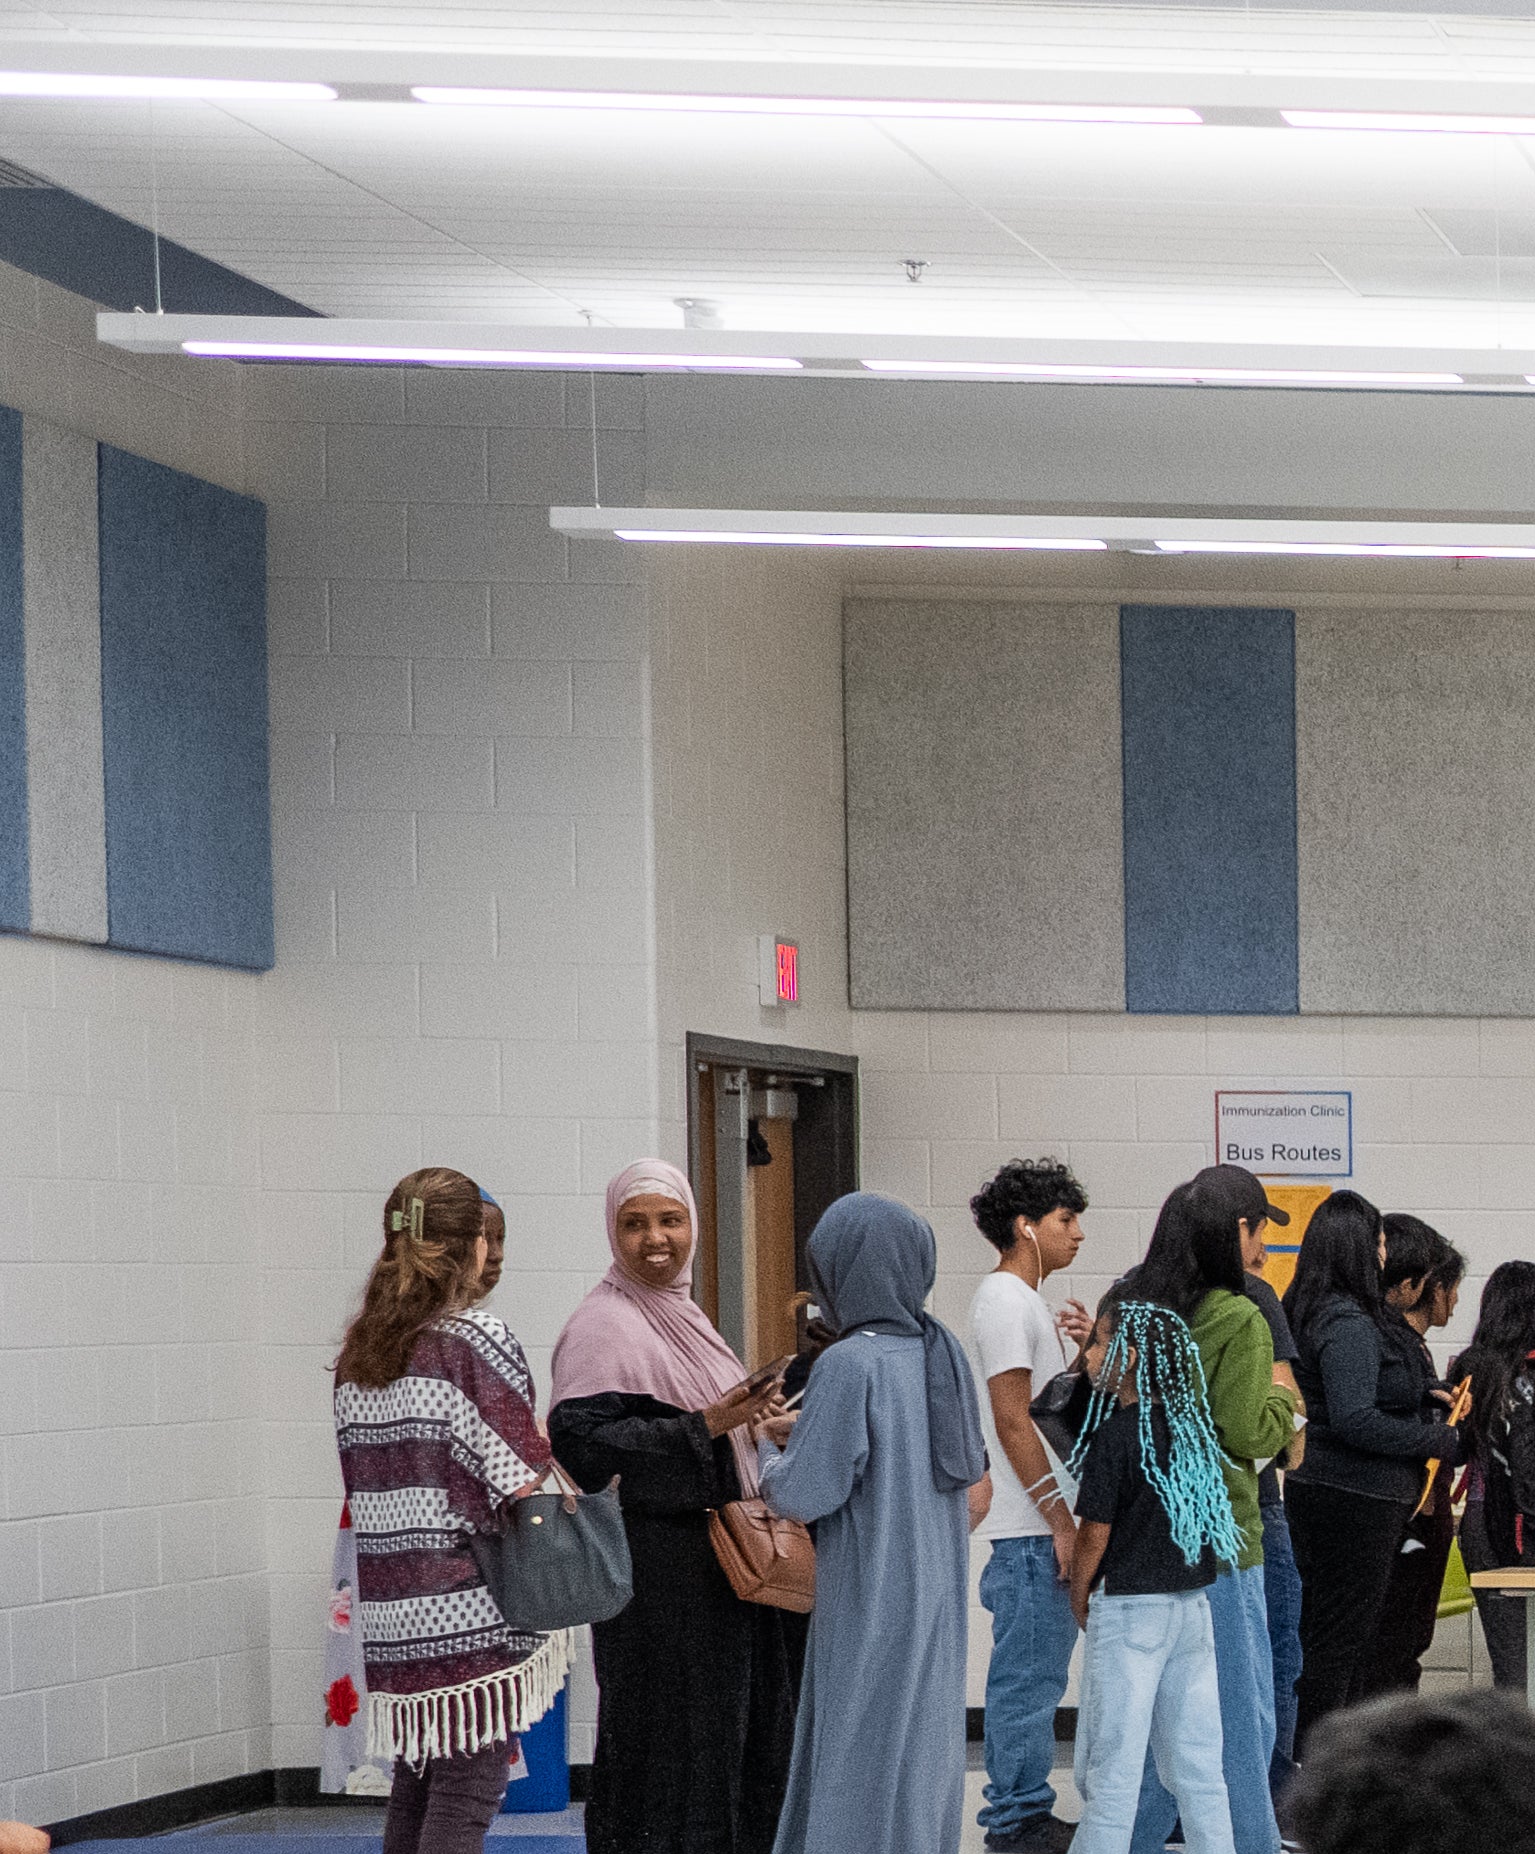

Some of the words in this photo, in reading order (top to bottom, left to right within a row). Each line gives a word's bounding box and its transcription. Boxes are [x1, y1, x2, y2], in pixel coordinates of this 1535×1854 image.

[776, 944, 798, 1001] EXIT
[1222, 1105, 1307, 1117] Immunization
[1310, 1105, 1345, 1117] Clinic
[1226, 1143, 1264, 1161] Bus
[1272, 1143, 1341, 1161] Routes
